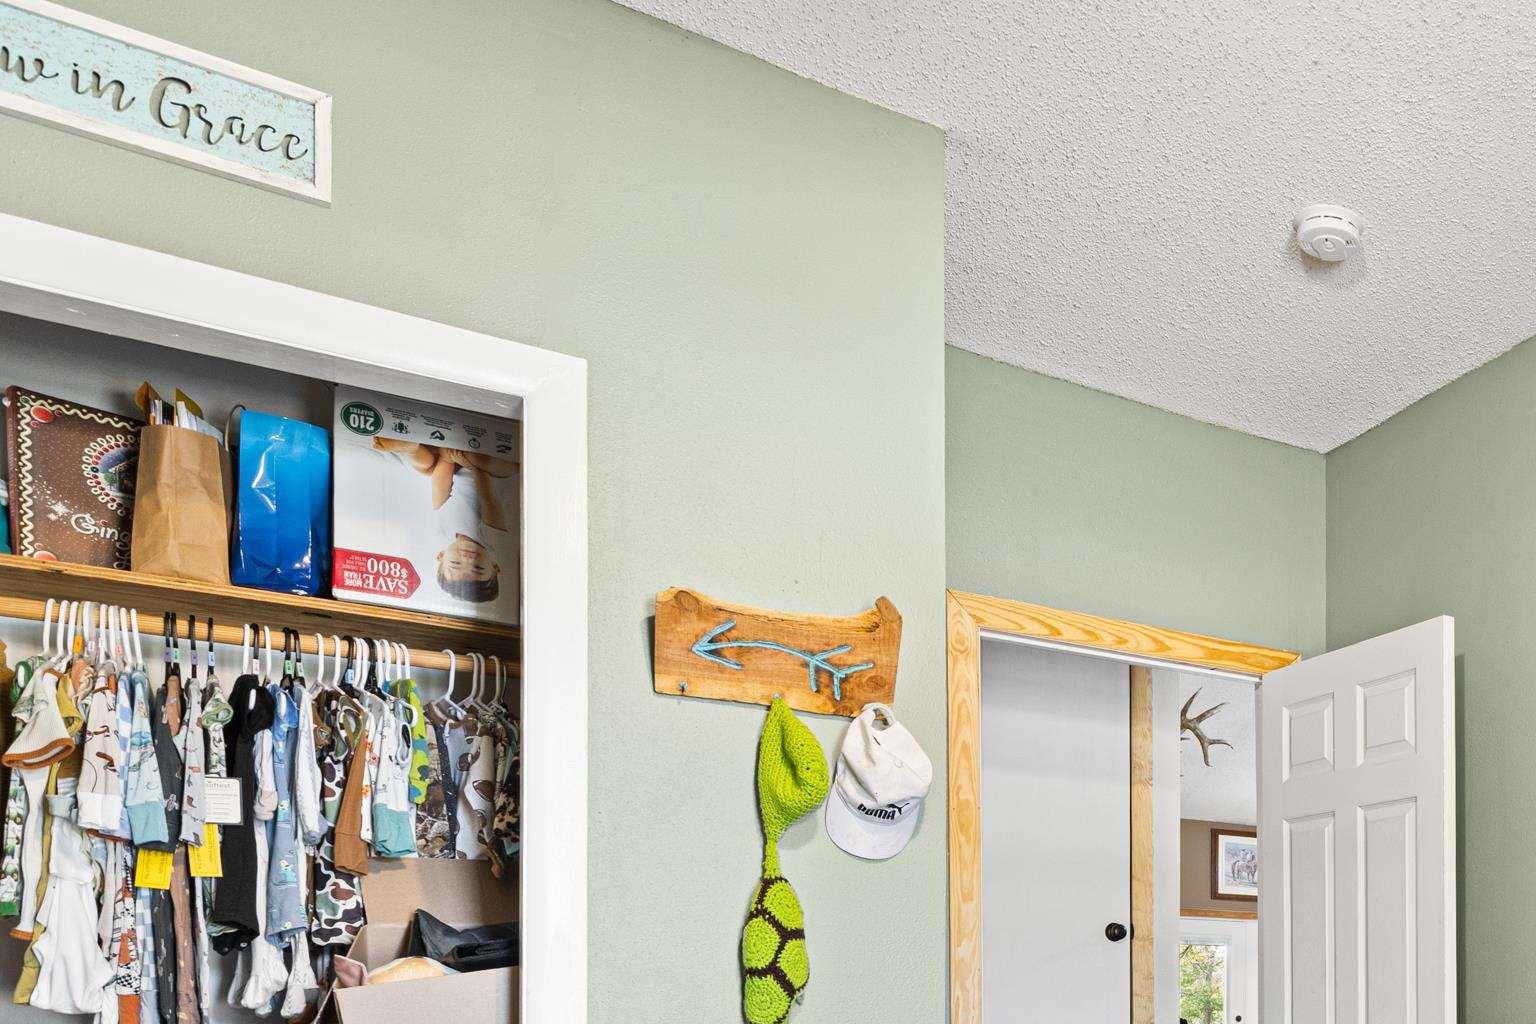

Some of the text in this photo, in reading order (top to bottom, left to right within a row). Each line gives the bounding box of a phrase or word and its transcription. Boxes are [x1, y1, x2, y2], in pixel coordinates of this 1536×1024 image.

[71, 62, 136, 112] in
[149, 76, 308, 161] Grace
[349, 413, 376, 431] 210
[366, 557, 409, 580] $800
[363, 574, 409, 595] SAVE
